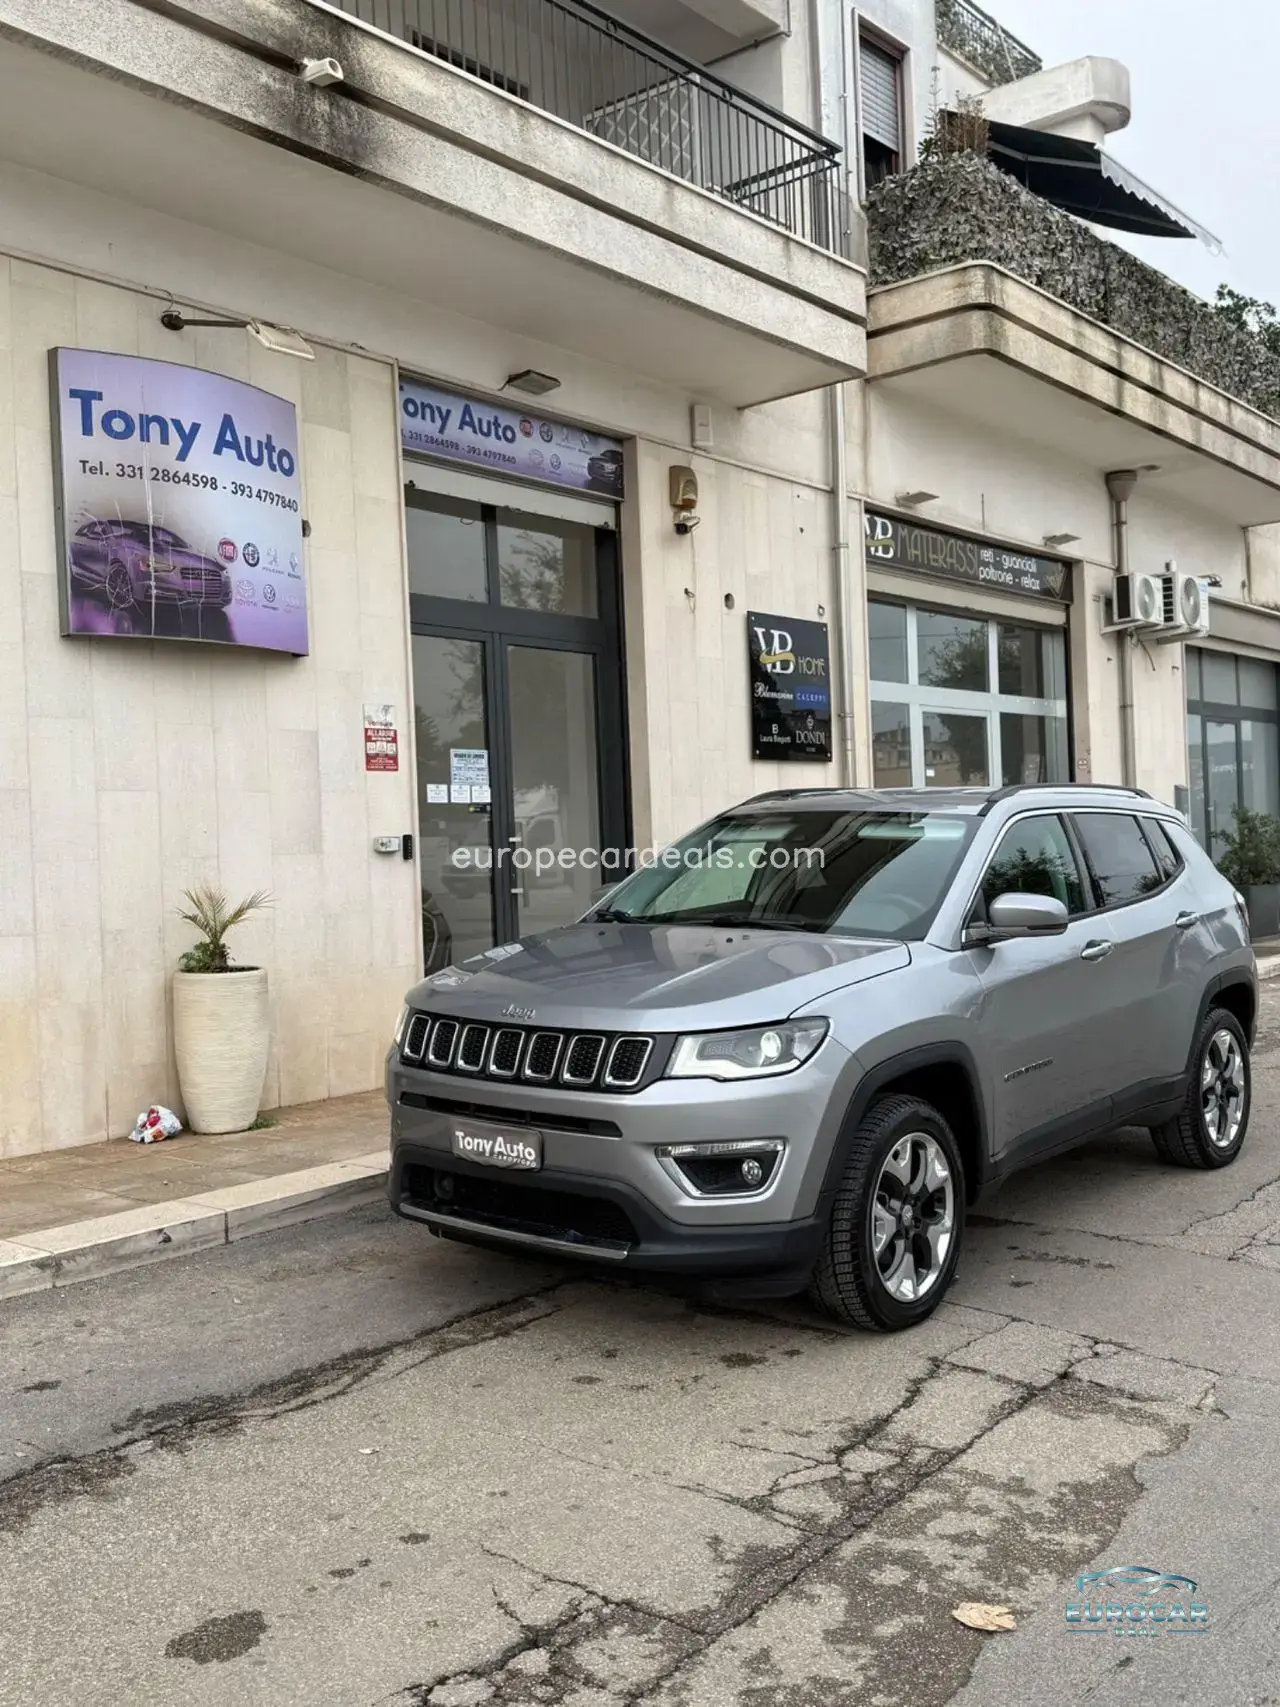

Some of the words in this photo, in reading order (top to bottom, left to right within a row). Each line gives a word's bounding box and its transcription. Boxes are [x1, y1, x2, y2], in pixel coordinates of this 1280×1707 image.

[69, 388, 201, 462] Tony
[213, 413, 295, 477] Auto
[400, 385, 452, 435] ony
[458, 403, 516, 444] Auto
[79, 460, 109, 476] Tel.
[116, 463, 143, 480] 331
[151, 467, 218, 490] 2864598
[231, 482, 253, 499] 393
[255, 488, 298, 512] 4797840
[898, 527, 979, 576] MATERASSI
[980, 548, 993, 561] reti
[1002, 554, 1037, 573] guanciali
[978, 566, 1013, 585] poltrone
[1021, 574, 1040, 590] relax
[798, 656, 825, 677] HOME
[796, 730, 825, 745] DONDI
